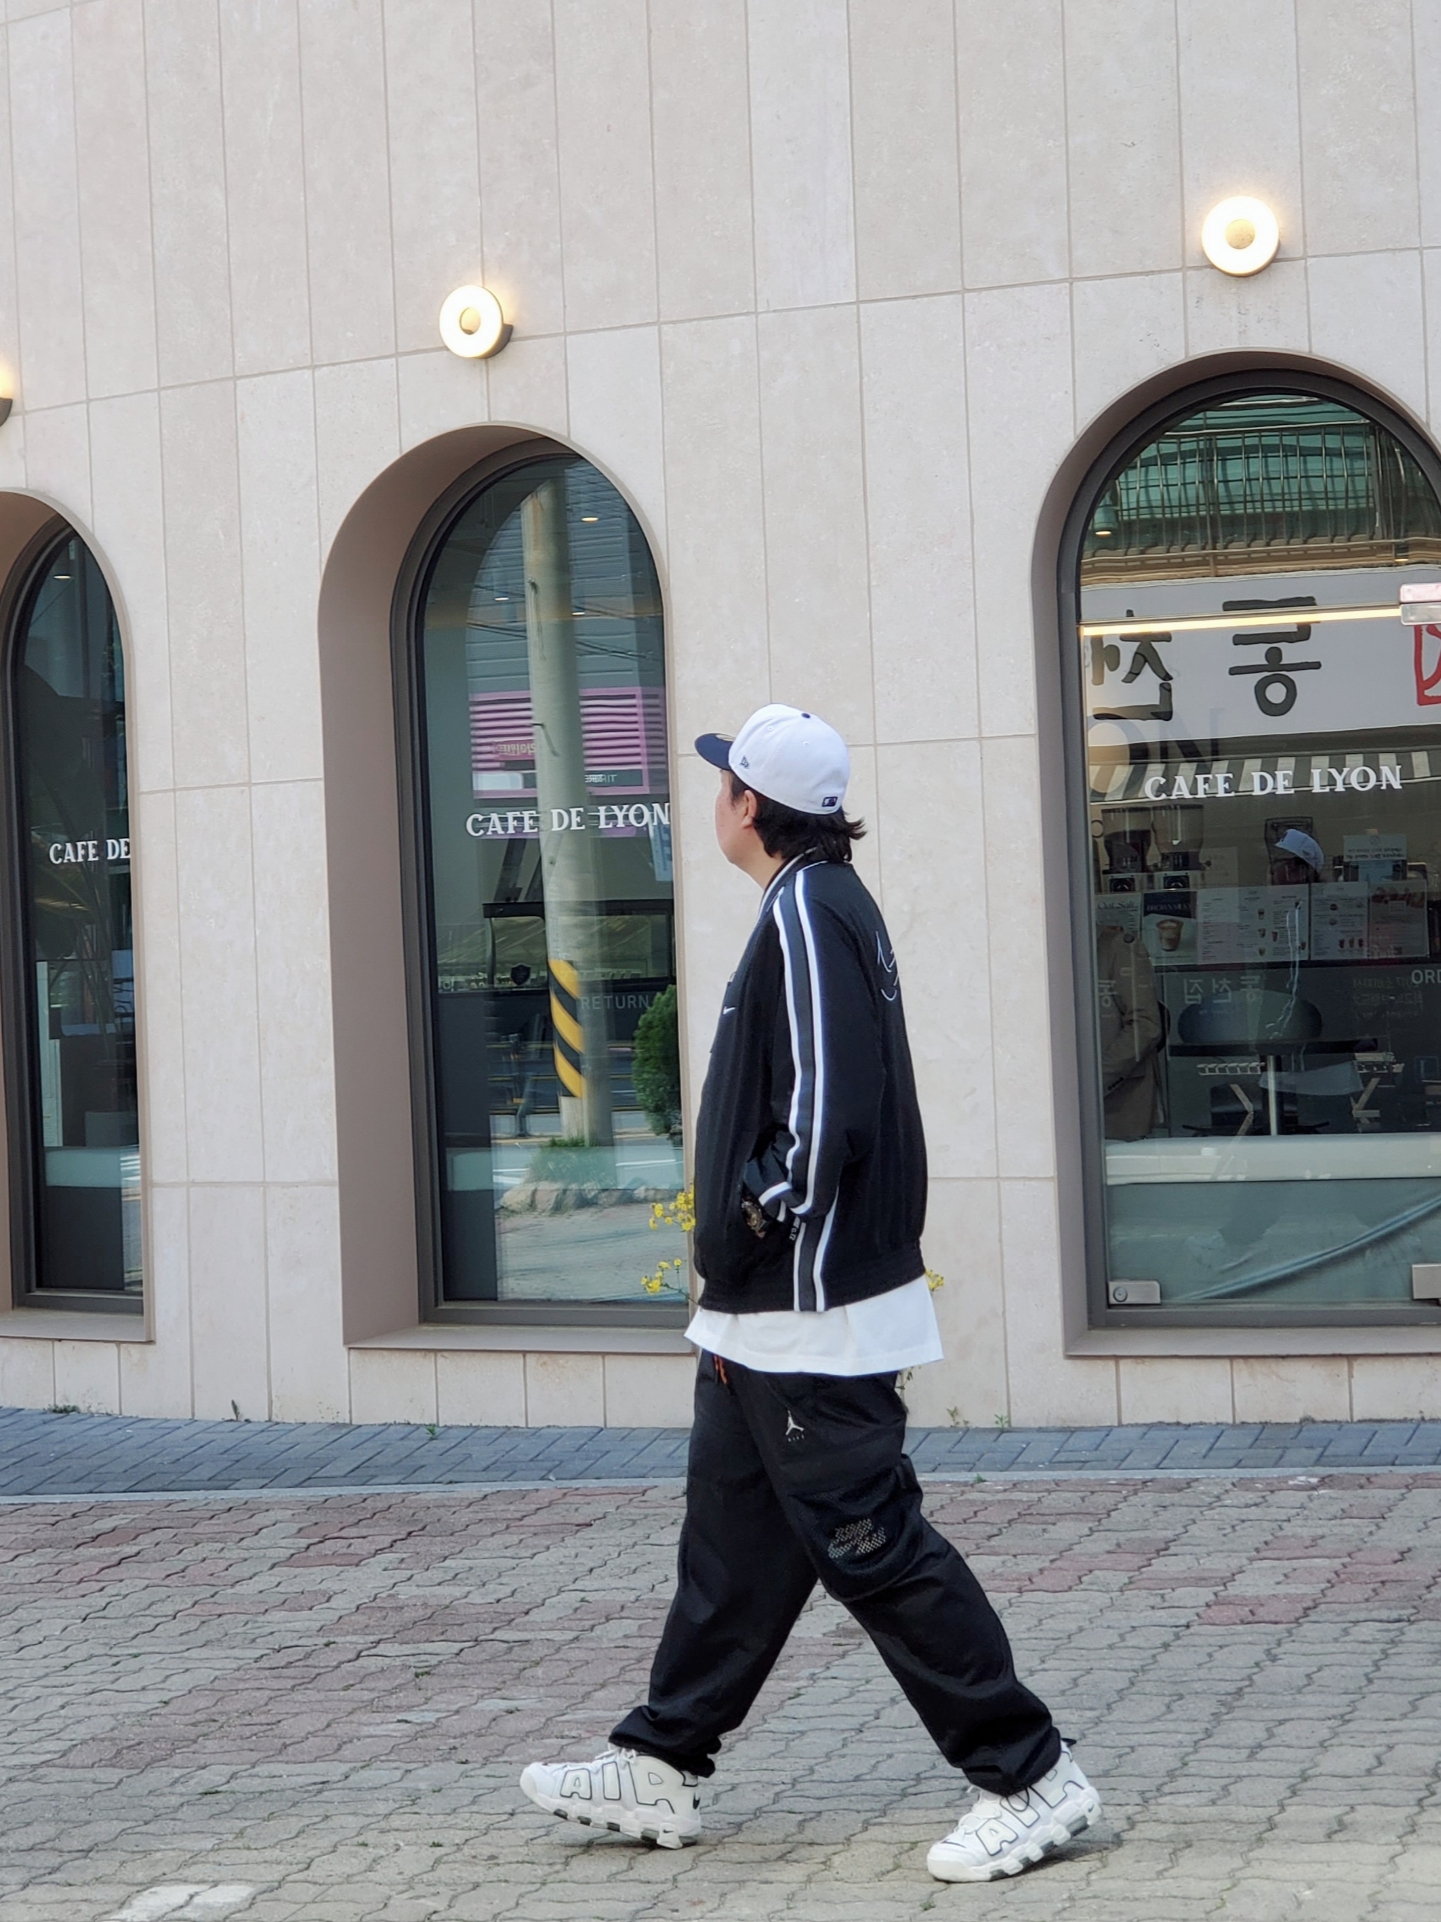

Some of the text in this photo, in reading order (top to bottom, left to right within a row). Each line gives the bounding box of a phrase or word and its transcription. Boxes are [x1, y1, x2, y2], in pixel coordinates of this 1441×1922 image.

[1144, 764, 1402, 800] CAFE DE LYON
[466, 802, 670, 837] CAFE DE LYON
[49, 838, 131, 865] CAFE DE
[580, 994, 649, 1010] RETURN
[560, 1755, 697, 1814] AIR
